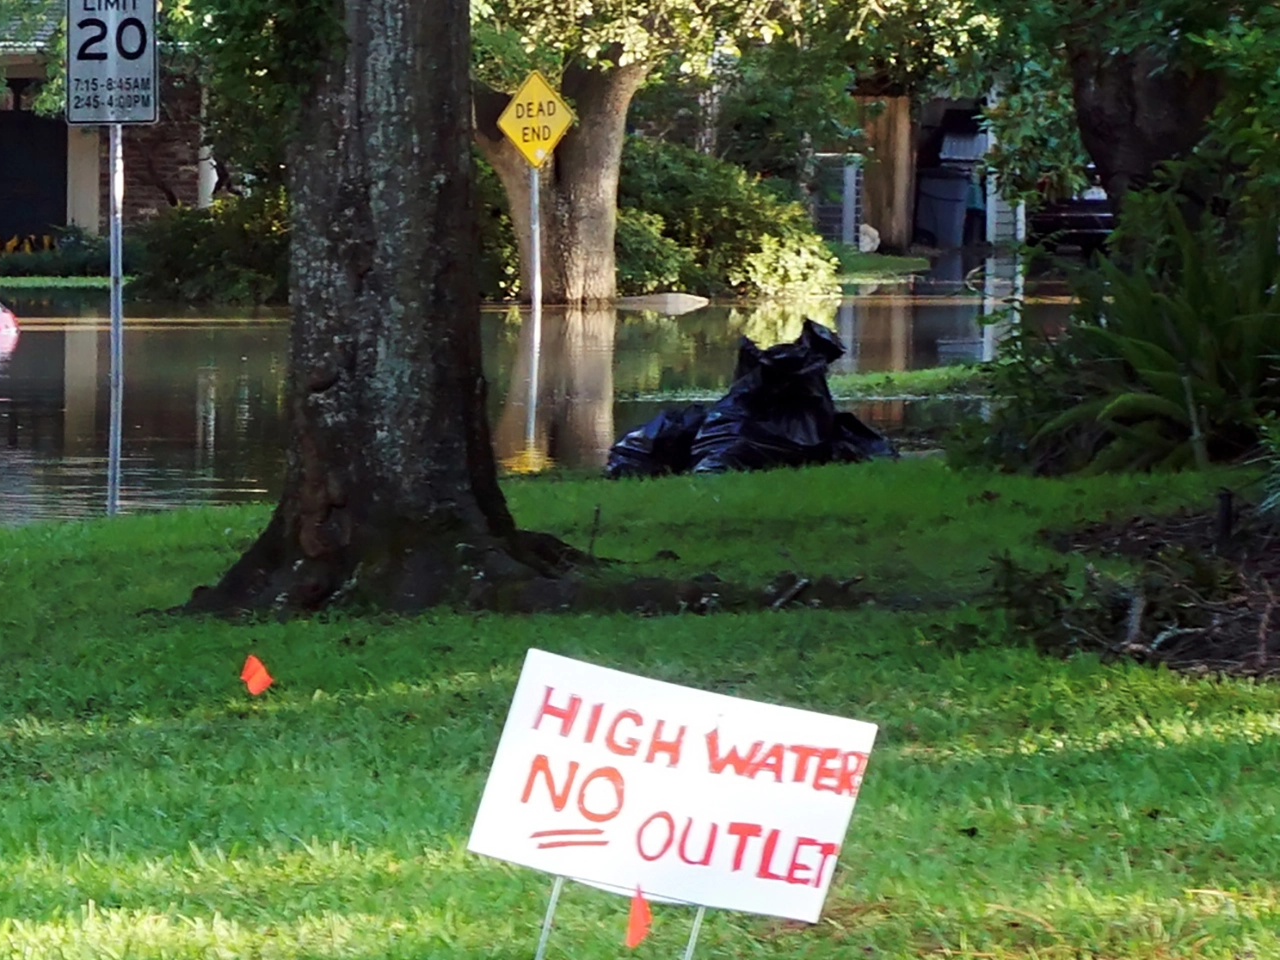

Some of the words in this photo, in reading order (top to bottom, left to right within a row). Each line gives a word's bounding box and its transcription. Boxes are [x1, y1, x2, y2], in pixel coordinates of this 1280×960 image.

[77, 17, 147, 60] 20
[515, 100, 556, 119] DEAD
[522, 125, 551, 142] END
[532, 685, 686, 768] HIGH
[705, 727, 868, 797] WATER
[521, 754, 624, 822] NO
[637, 810, 840, 888] OUTLET
